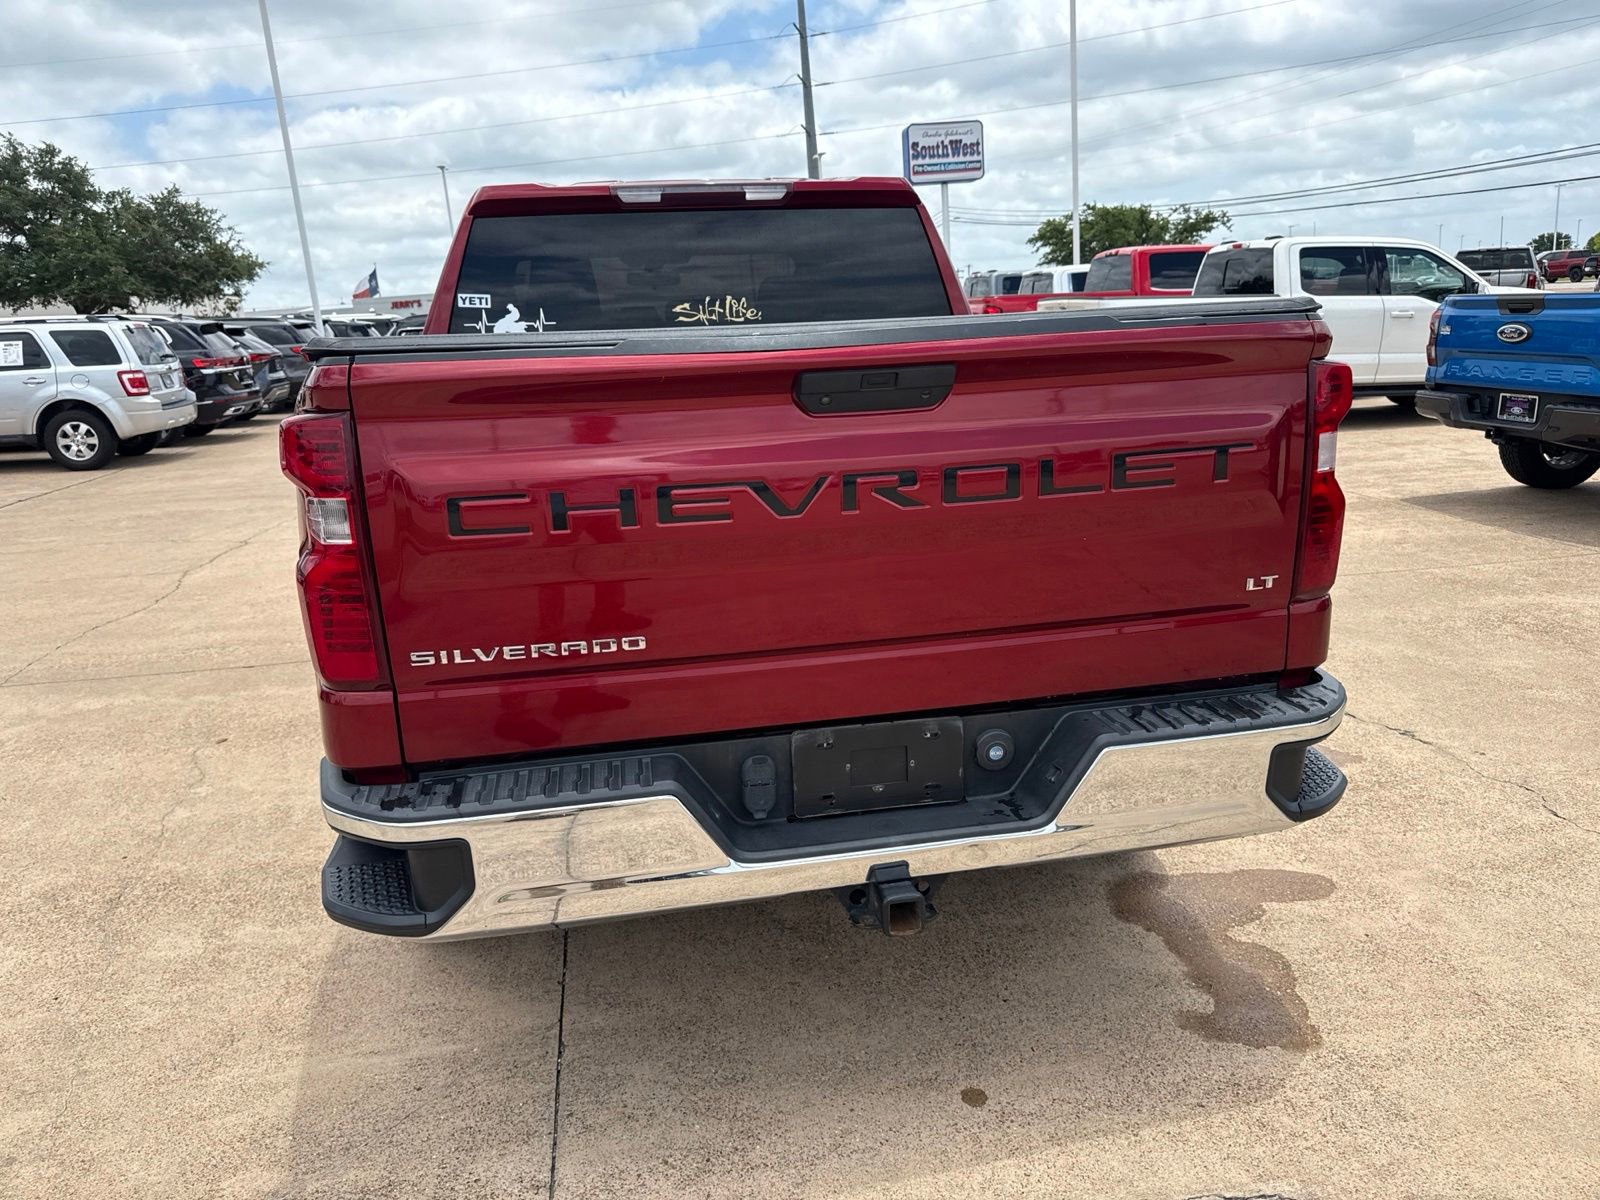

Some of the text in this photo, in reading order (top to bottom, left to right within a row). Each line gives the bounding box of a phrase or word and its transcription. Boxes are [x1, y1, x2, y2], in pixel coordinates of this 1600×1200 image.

[911, 138, 981, 160] SouthWest
[391, 299, 422, 309] JERRY'S
[460, 296, 489, 306] YETI
[447, 442, 1257, 538] CHEVROLET
[1246, 575, 1279, 591] LT
[410, 636, 647, 666] SILVERADO
